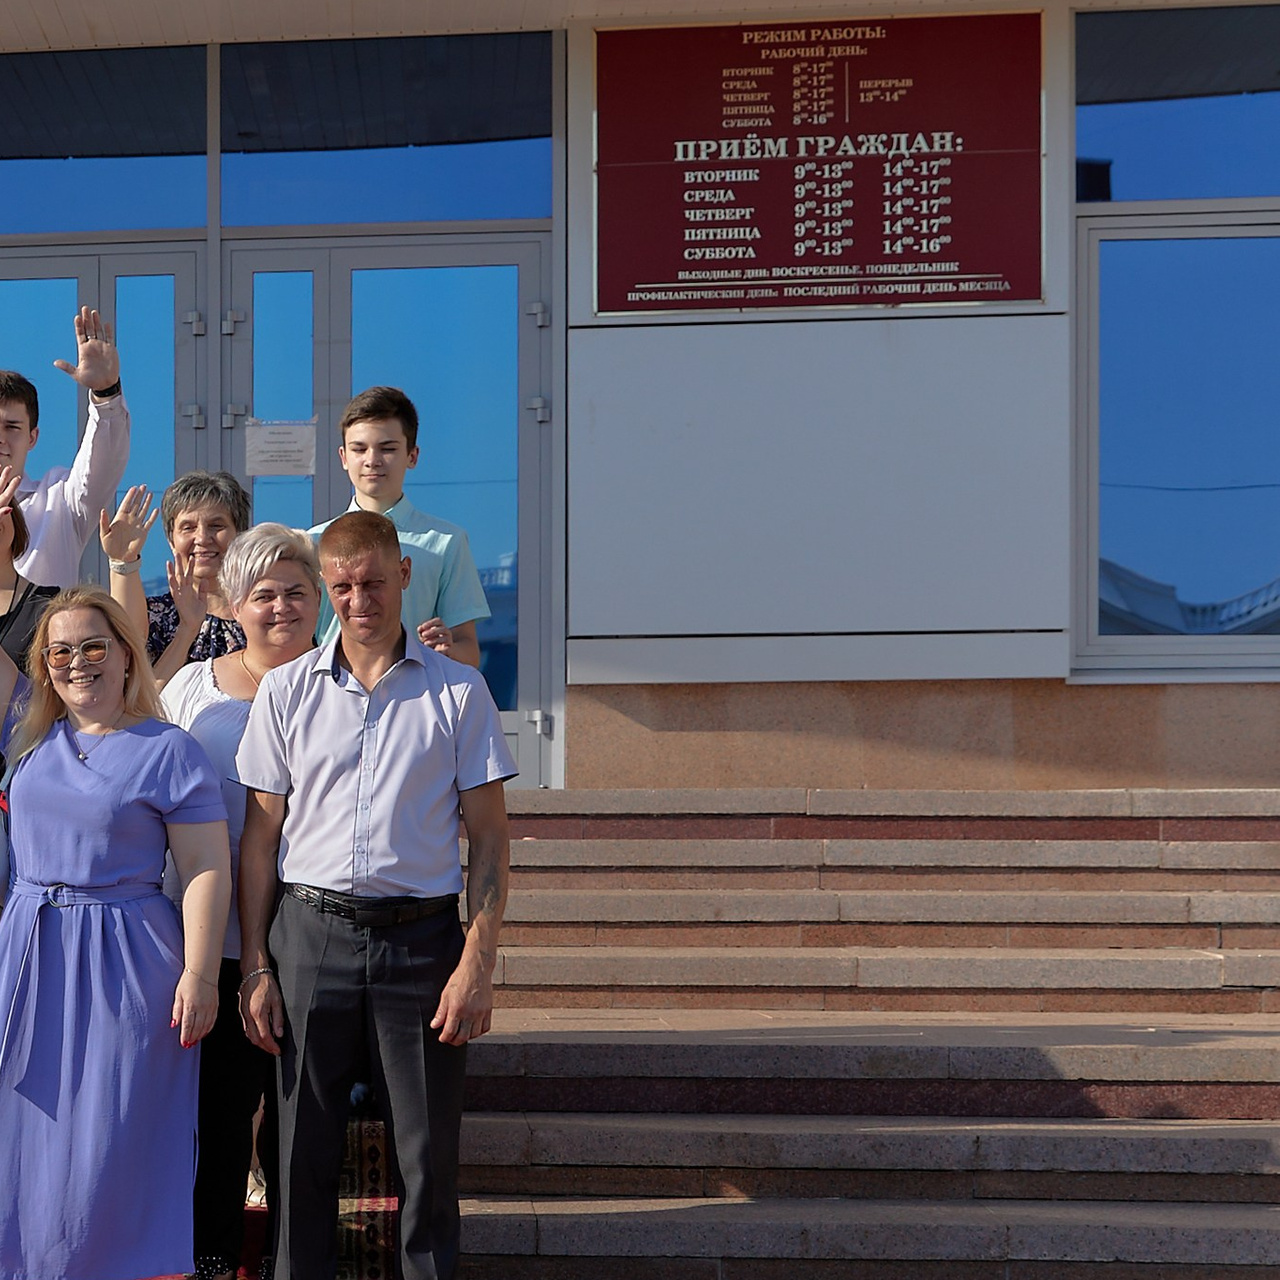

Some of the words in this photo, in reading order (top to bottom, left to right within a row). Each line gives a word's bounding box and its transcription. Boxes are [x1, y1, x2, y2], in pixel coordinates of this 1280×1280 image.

[742, 30, 806, 44] РЕЖИМ
[810, 26, 887, 41] РАБОТЫ:
[761, 45, 825, 59] РАБОЧИЙ
[827, 45, 868, 58] ДЕНЬ:
[722, 66, 774, 77] ВТОРНИК
[722, 80, 758, 90] СРЕДА
[859, 78, 914, 89] ПЕРЕРЫВ
[722, 92, 771, 102] ЧЕТВЕРГ
[722, 105, 776, 116] ПЯТНИЦА
[722, 118, 772, 128] СУББОТА
[674, 134, 789, 162] ПРИЁМ
[796, 132, 964, 159] ГРАЖДАН:
[684, 168, 760, 183] ВТОРНИК
[684, 190, 736, 203] СРЕДА
[684, 208, 755, 222] ЧЕТВЕРГ
[684, 227, 761, 241] ПЯТНИЦА
[684, 246, 756, 260] СУББОТА
[678, 269, 742, 280] ВЫХОДНЫЕ
[866, 262, 960, 275] ПОНЕДЕЛЬНИК
[784, 283, 860, 297] ПОСЛЕДНИЙ
[922, 282, 957, 294] ДЕНЬ
[958, 280, 1011, 293] МЕСЯЦА
